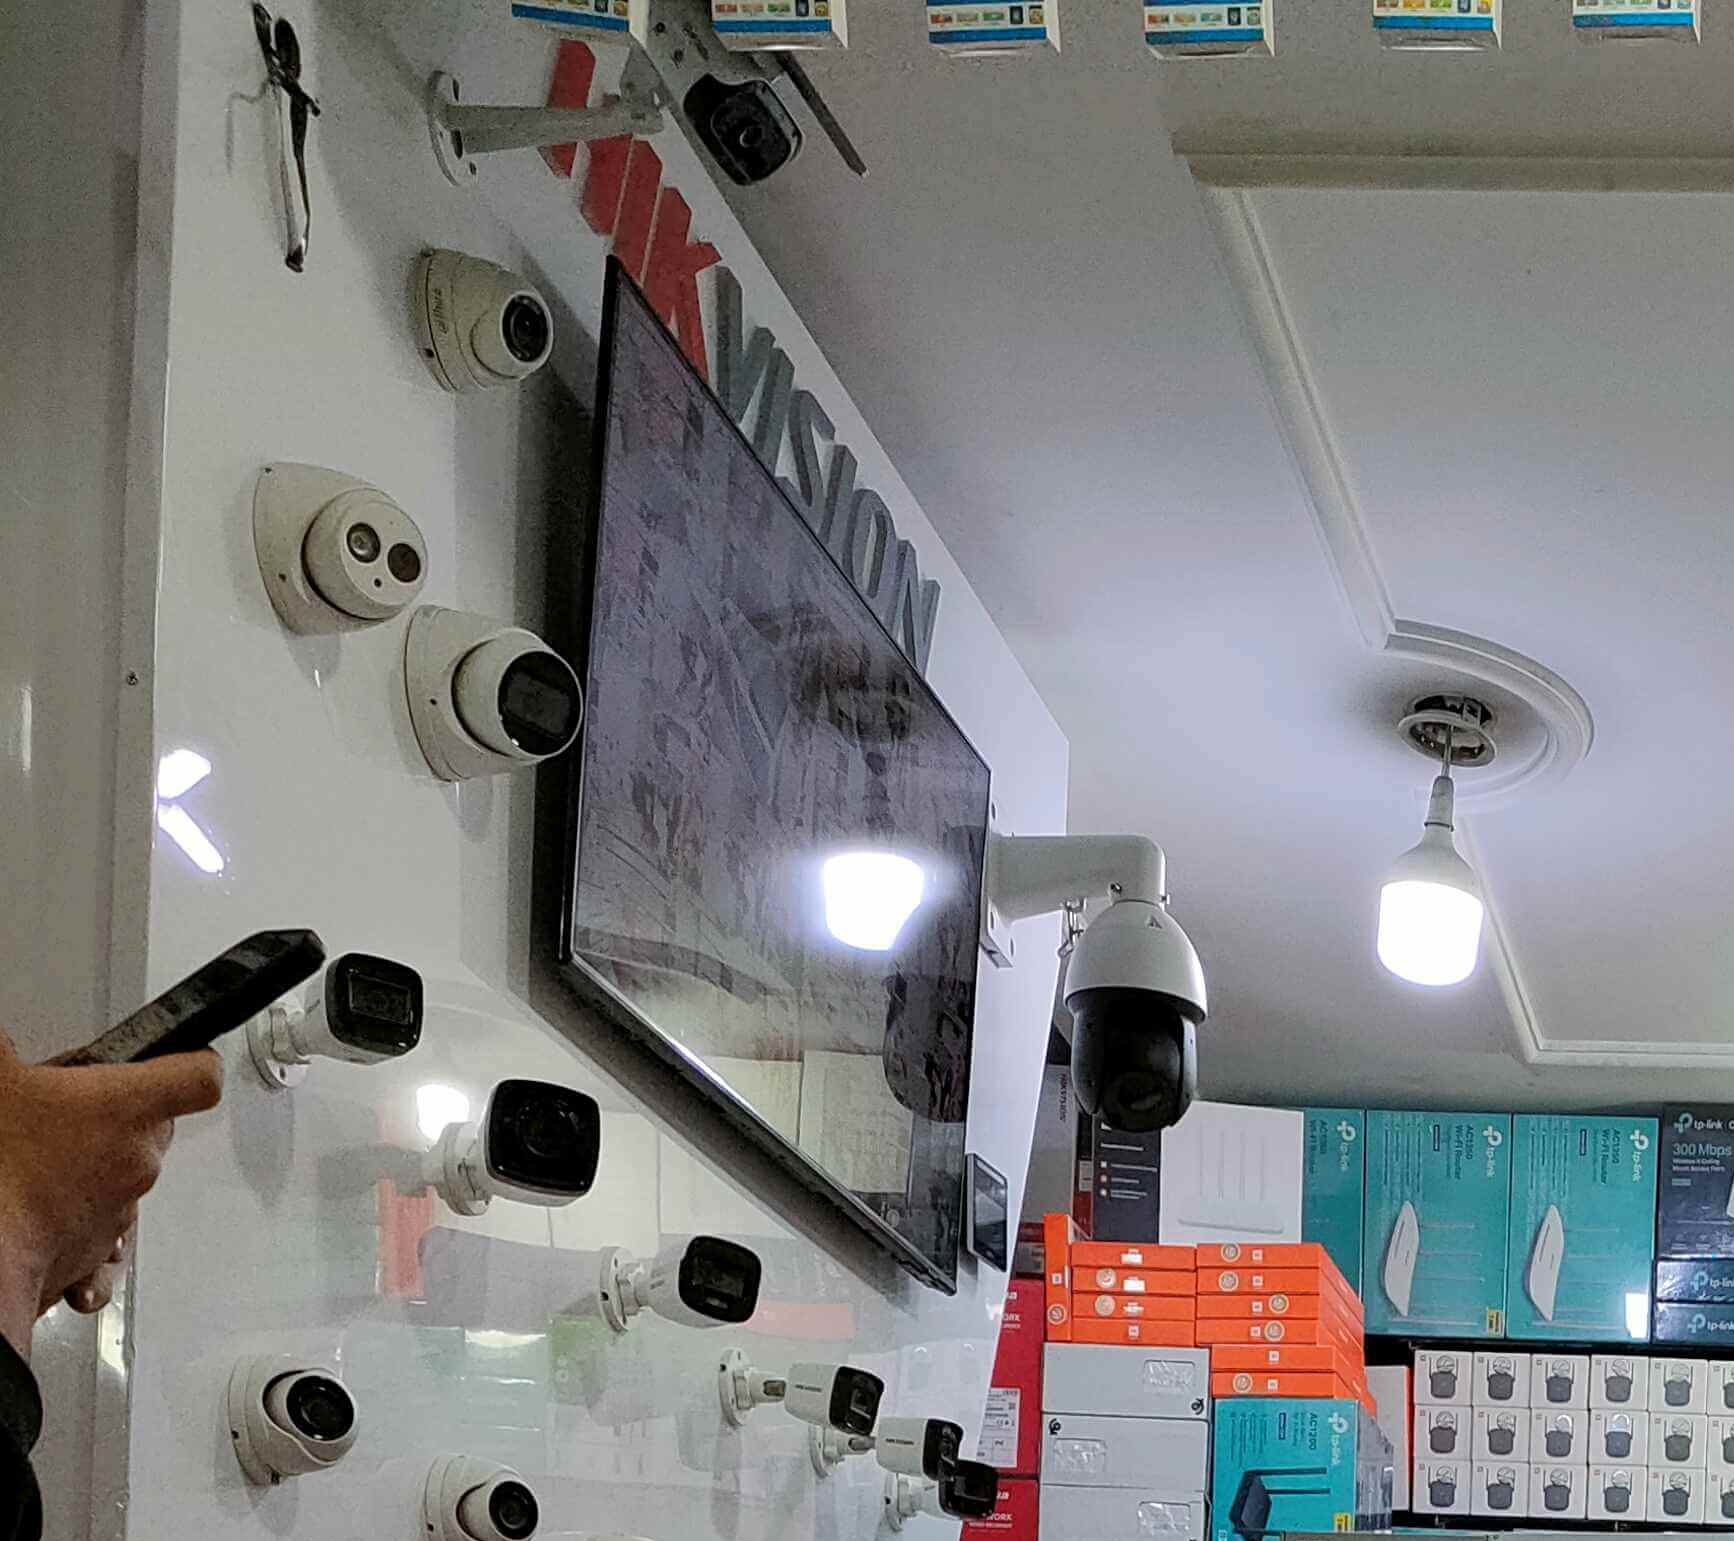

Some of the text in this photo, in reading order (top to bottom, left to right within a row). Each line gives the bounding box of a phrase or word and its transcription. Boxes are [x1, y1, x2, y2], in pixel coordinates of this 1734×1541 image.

[1693, 1116, 1724, 1131] tp-link
[1672, 1143, 1732, 1158] 300 Mbps
